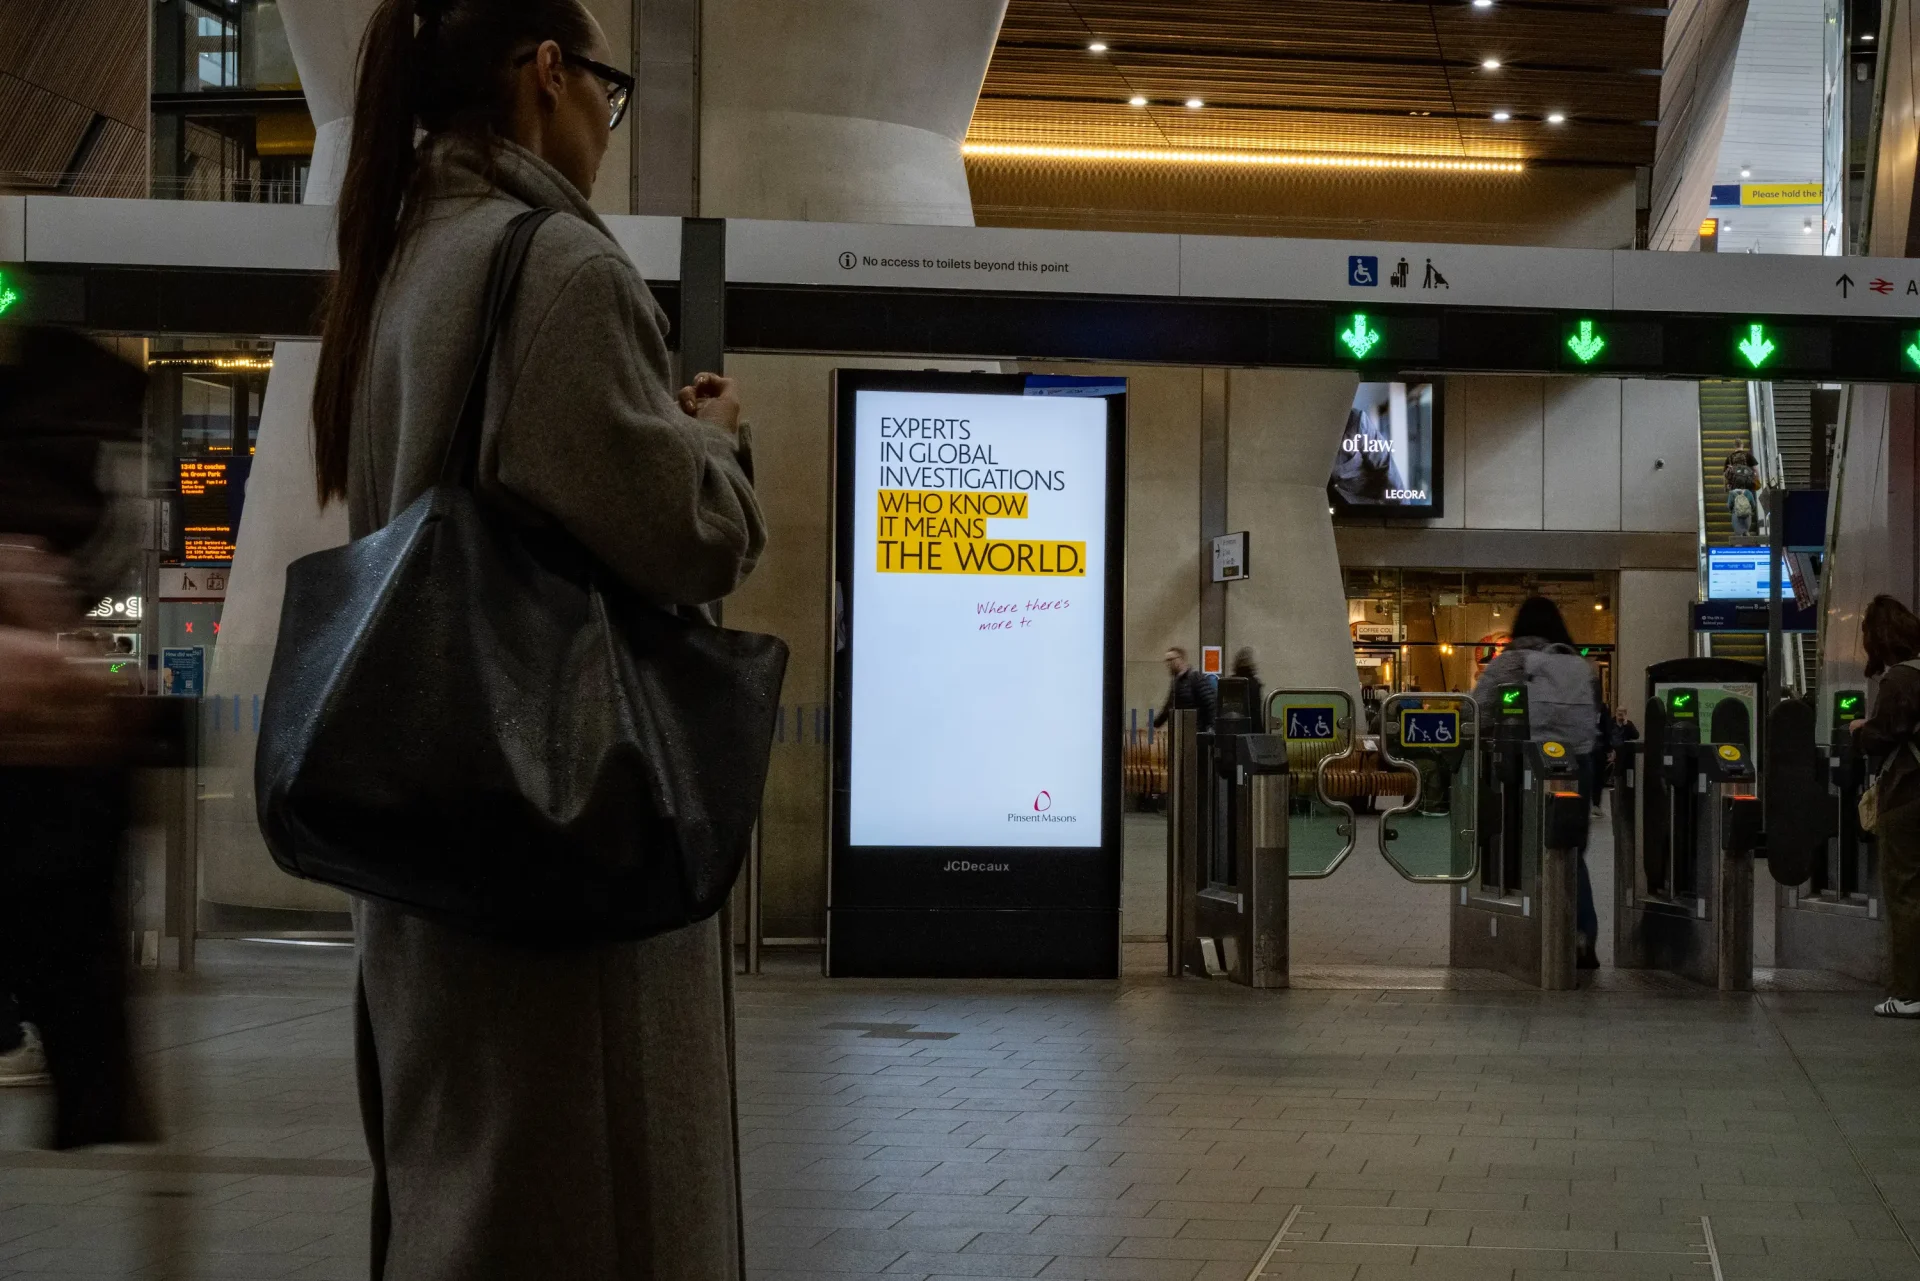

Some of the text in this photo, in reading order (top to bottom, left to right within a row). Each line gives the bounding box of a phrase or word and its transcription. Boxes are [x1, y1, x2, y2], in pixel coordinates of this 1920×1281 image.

[1752, 190, 1779, 198] Please
[862, 256, 1069, 274] No access to toilets beyond this point
[1906, 280, 1918, 295] A
[881, 417, 970, 440] EXPERTS
[1342, 434, 1396, 453] of law.
[881, 442, 998, 465] IN GLOBAL
[880, 466, 1065, 491] INVESTIGATIONS
[1385, 490, 1426, 499] LEGORA
[879, 492, 1027, 516] WHO KNOW
[879, 517, 984, 539] IT MEANS
[878, 541, 1084, 573] THE WORLD.
[977, 598, 1070, 614] Where there's
[979, 620, 1013, 630] more
[1008, 813, 1077, 822] Pinsent Masons
[944, 861, 1010, 871] JCDecaux
